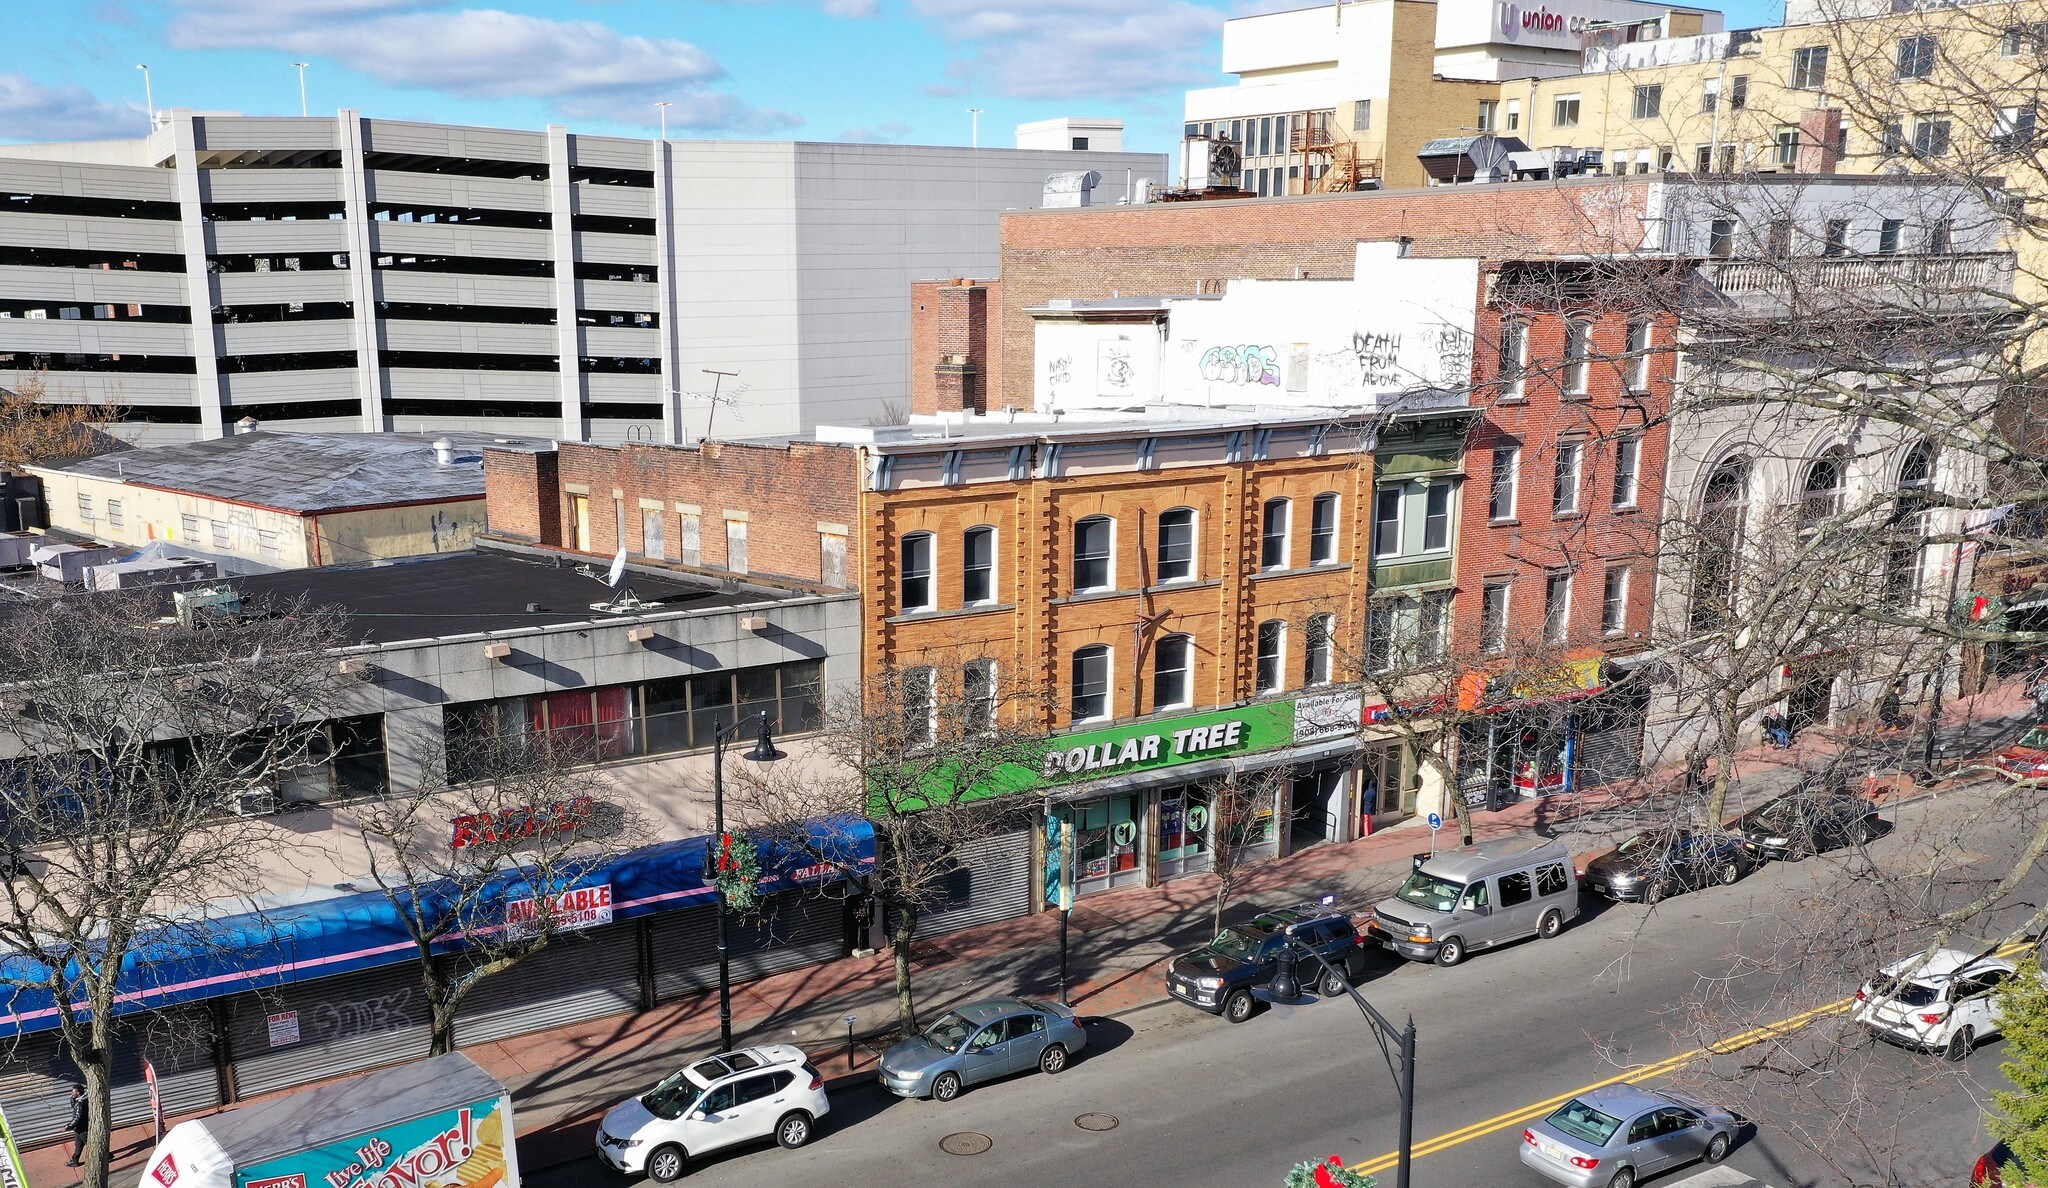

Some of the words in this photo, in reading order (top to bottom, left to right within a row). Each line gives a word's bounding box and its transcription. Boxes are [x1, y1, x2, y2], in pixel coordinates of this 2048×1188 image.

[1521, 6, 1563, 32] union
[1352, 331, 1402, 354] DEATH
[1359, 353, 1397, 371] FROM
[1362, 372, 1402, 387] ABOVE
[1331, 696, 1344, 704] For
[1043, 733, 1161, 778] DOLLAR
[1174, 720, 1243, 754] TREE
[794, 863, 839, 880] FALLA
[268, 1015, 280, 1023] FOR
[281, 1012, 297, 1020] RENT
[323, 1162, 362, 1188] Live
